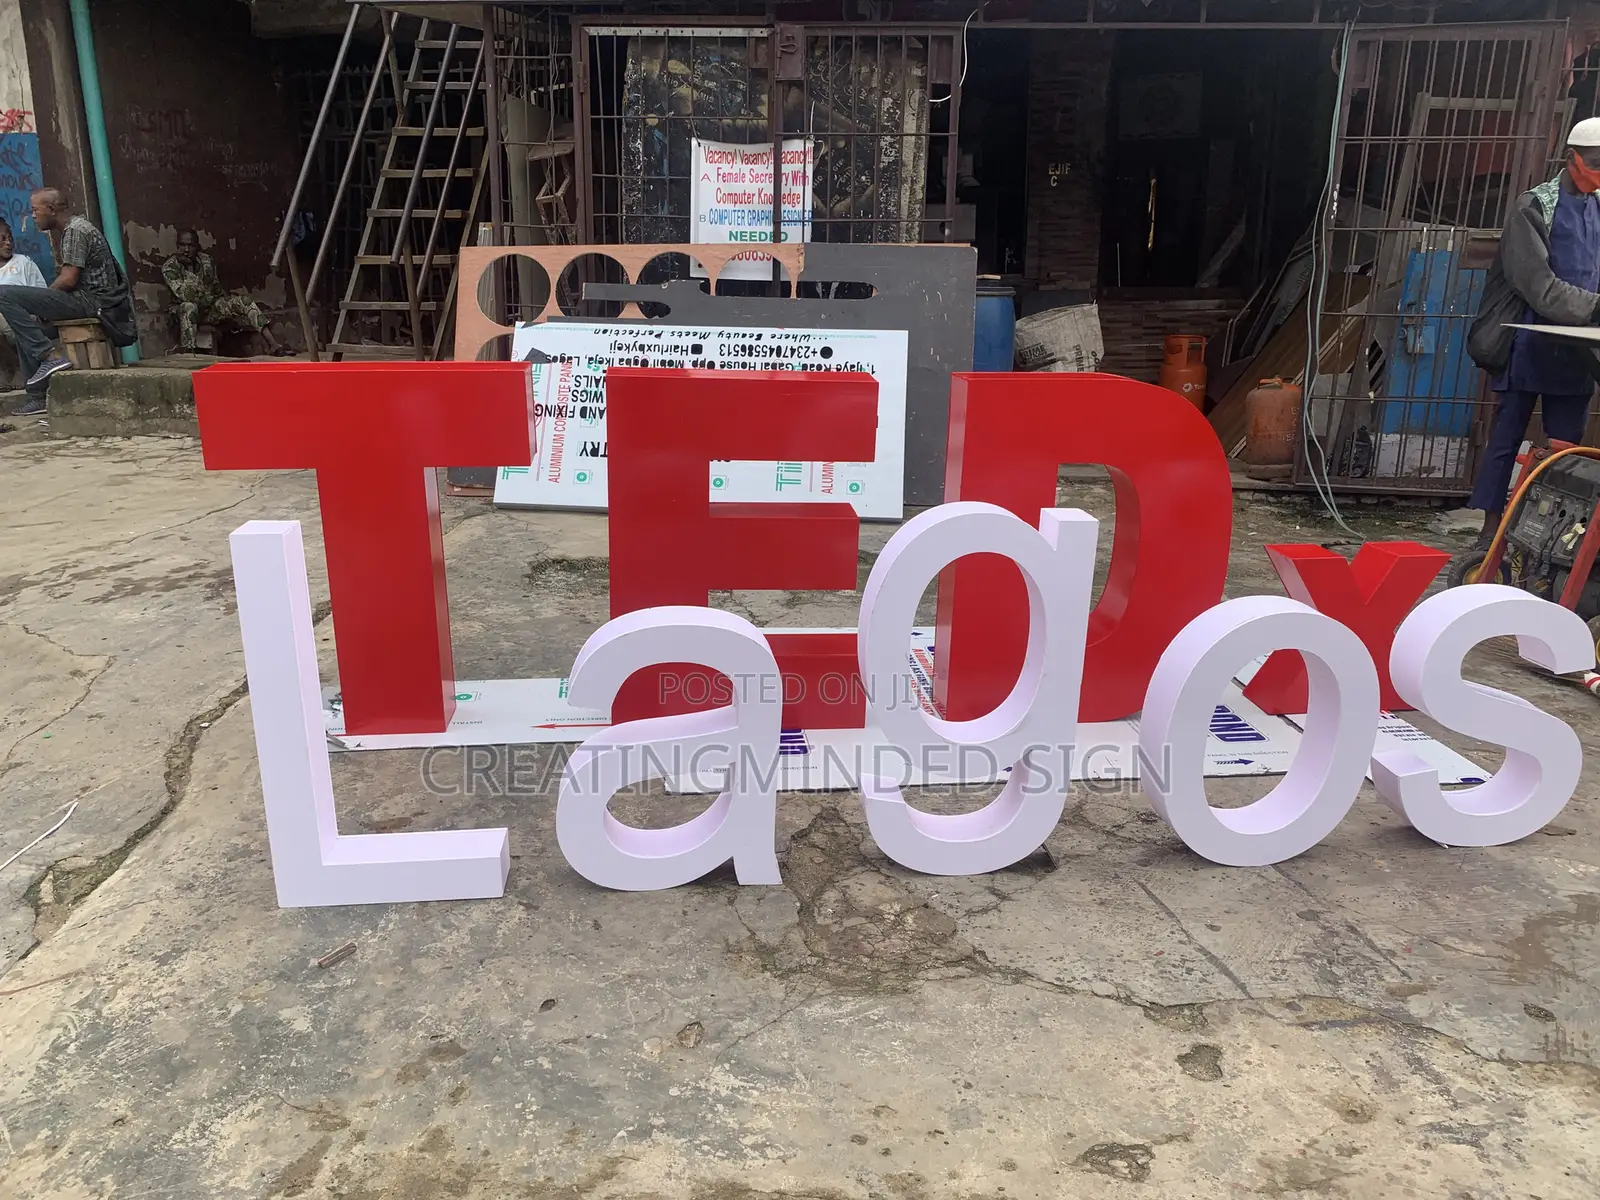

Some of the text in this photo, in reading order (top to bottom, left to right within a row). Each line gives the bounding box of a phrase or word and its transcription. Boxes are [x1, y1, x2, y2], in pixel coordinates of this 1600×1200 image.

[704, 146, 737, 169] Vacancy!
[716, 167, 746, 184] Female
[749, 168, 789, 186] Secrery
[716, 187, 801, 208] Computer Knoedge
[709, 208, 747, 226] COMPUTER
[593, 329, 664, 339] Perfection
[670, 330, 712, 340] Meets
[718, 331, 764, 341] Beauty
[609, 340, 689, 356] Hairluxbykeji
[535, 403, 607, 419] AND FIXING
[548, 434, 566, 484] ALUMINIUM
[229, 501, 1596, 909] Lagos
